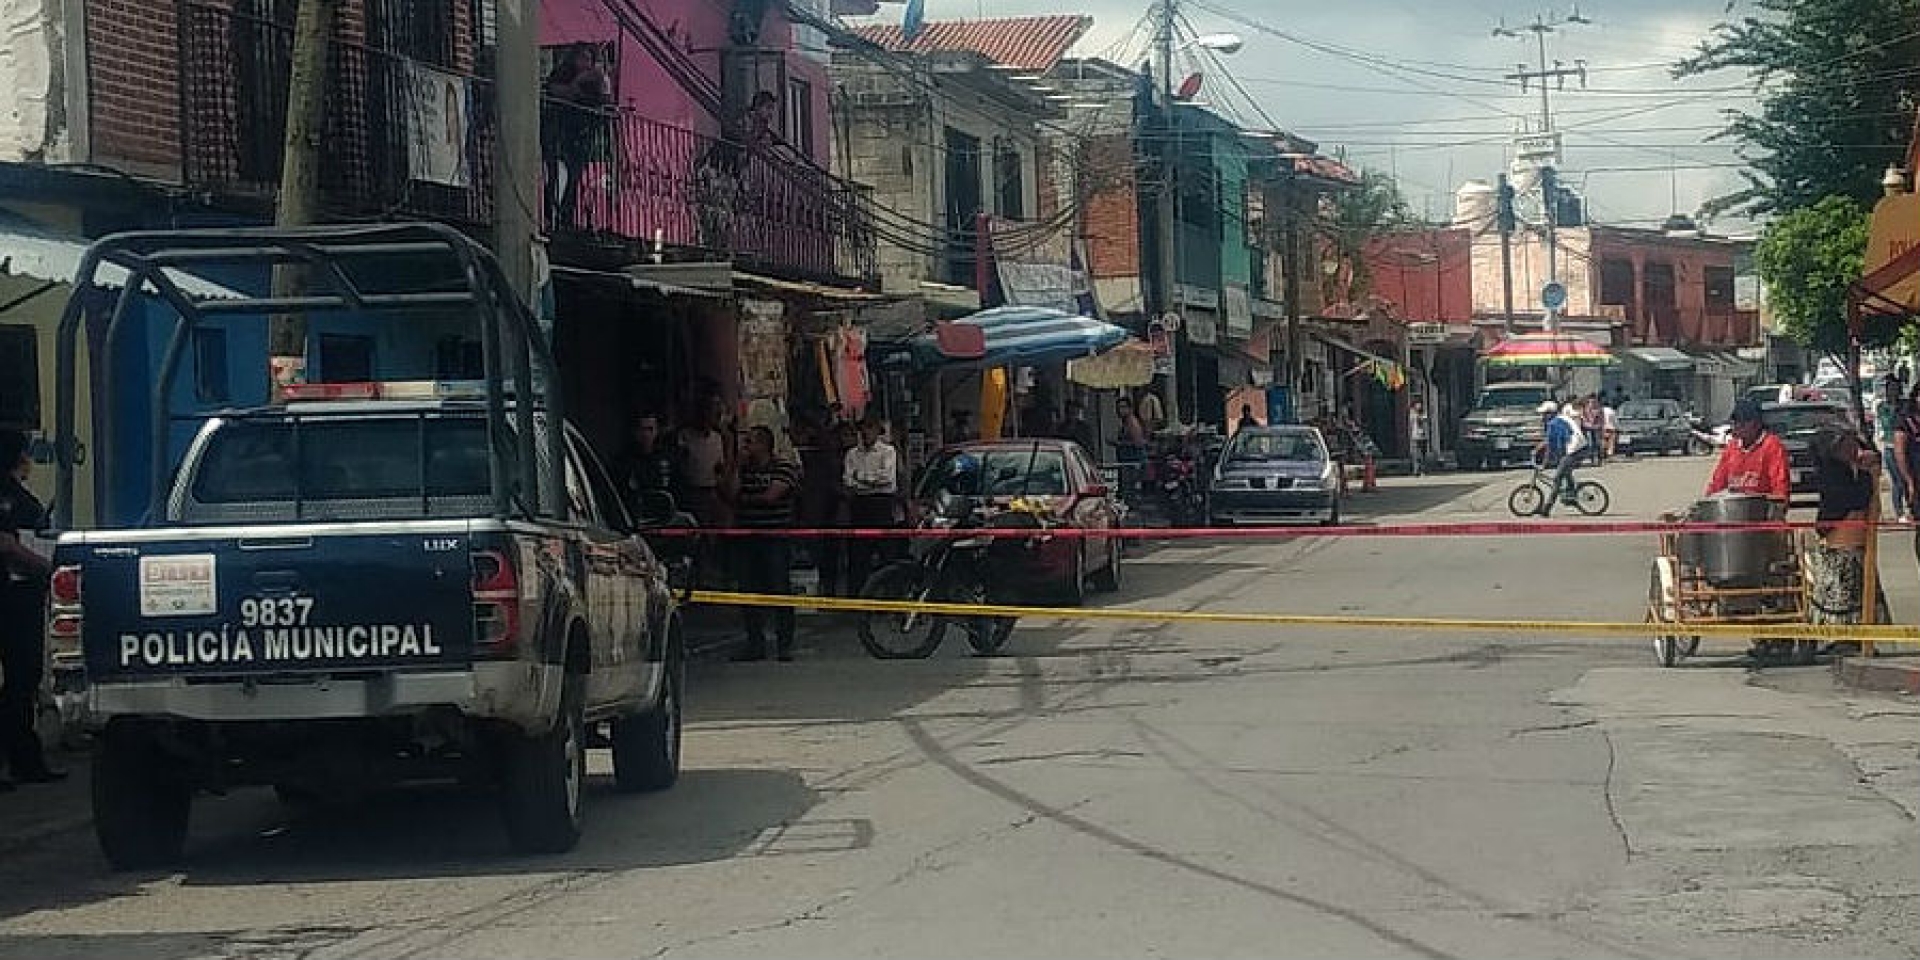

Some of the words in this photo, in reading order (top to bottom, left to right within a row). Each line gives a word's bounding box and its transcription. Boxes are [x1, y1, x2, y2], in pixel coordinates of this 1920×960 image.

[240, 598, 314, 626] 9837
[120, 623, 253, 666] POLICÍA
[263, 624, 441, 660] MUNICIPAL
